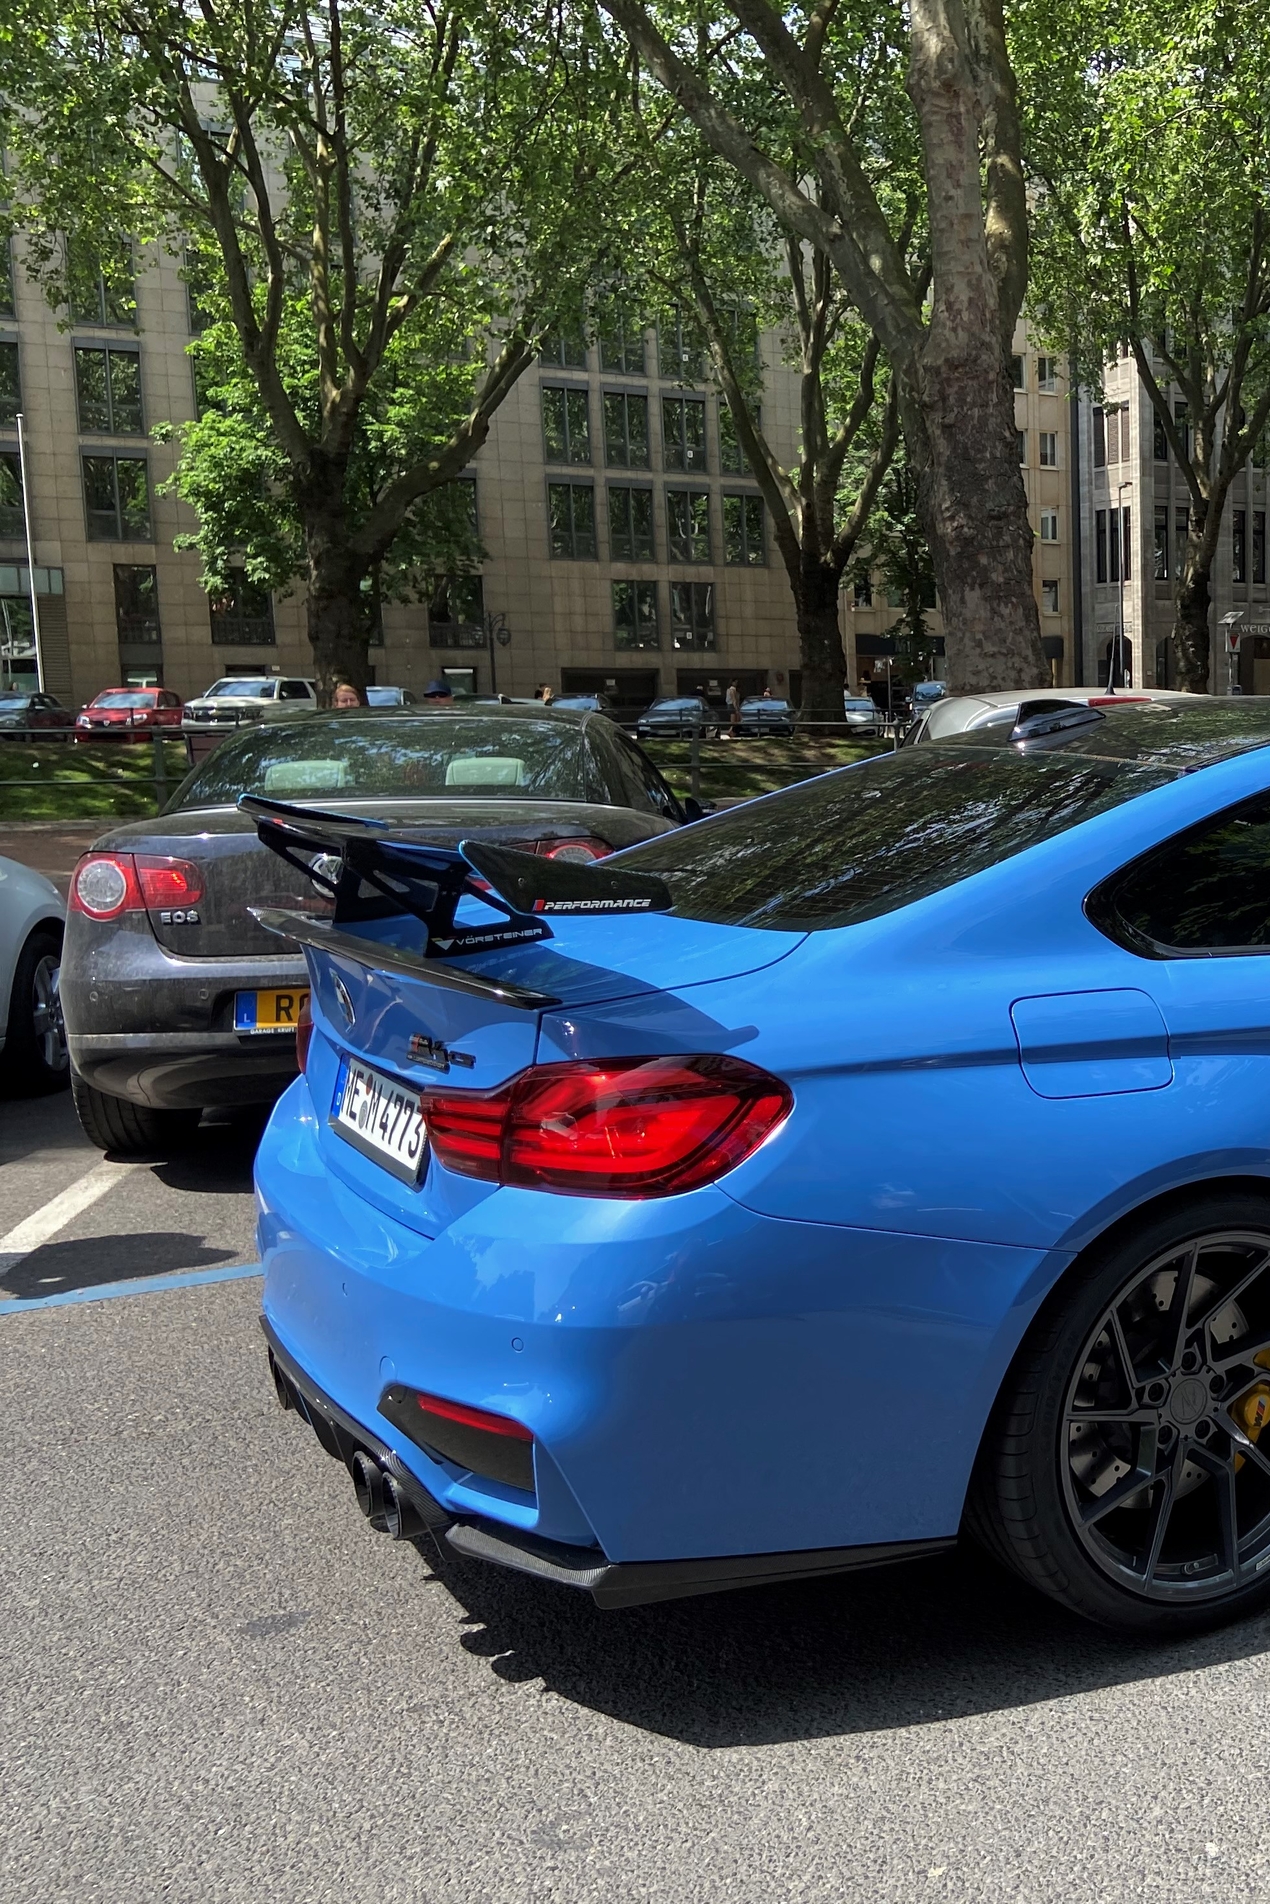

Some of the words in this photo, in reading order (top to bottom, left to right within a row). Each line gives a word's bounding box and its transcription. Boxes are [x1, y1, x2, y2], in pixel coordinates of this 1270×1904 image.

[544, 899, 651, 910] PERFORMANCE
[161, 910, 198, 923] EOS
[456, 928, 542, 946] VÖRSTEINER
[244, 1013, 250, 1022] L
[341, 1066, 364, 1121] ME
[366, 1080, 383, 1134] M
[379, 1089, 423, 1159] 4773
